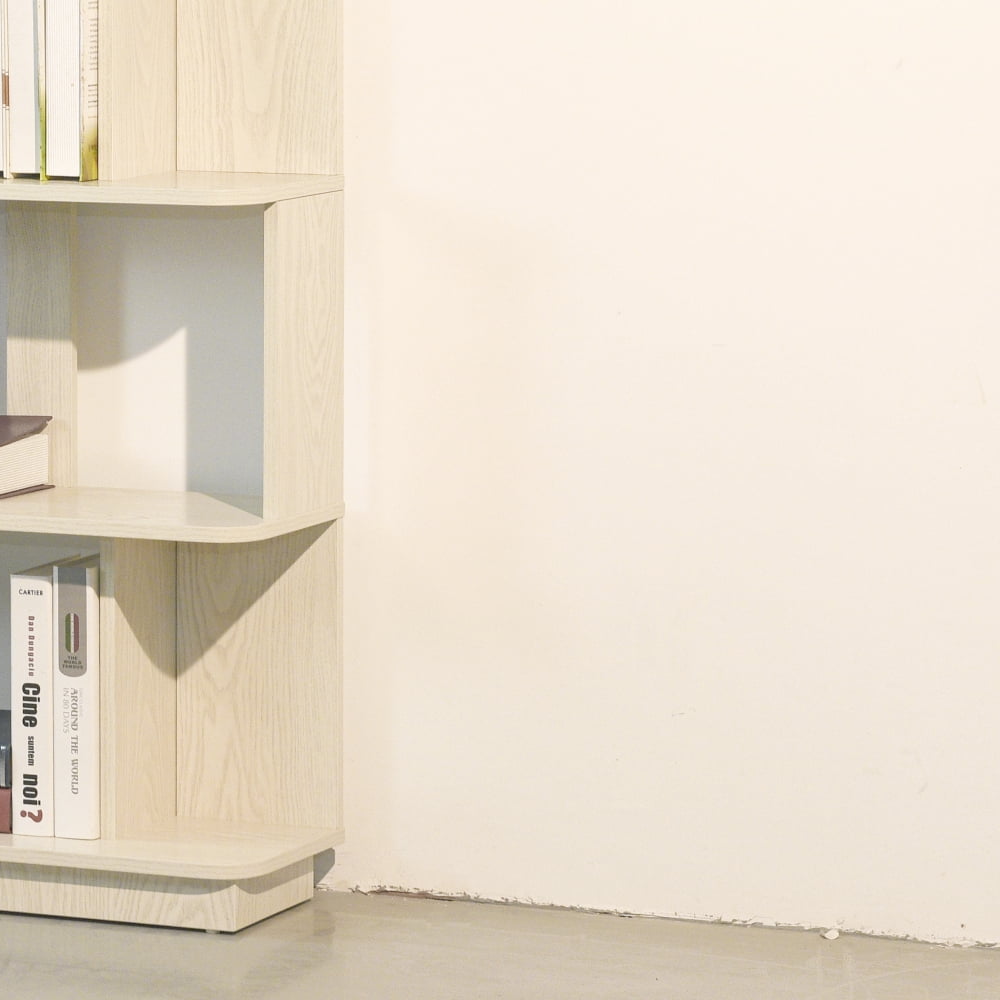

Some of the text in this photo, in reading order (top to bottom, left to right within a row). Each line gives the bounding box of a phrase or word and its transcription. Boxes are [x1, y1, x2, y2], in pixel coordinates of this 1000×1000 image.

[20, 682, 44, 823] Cine suntem noi?
[70, 687, 79, 795] AROUND THE WORLD
